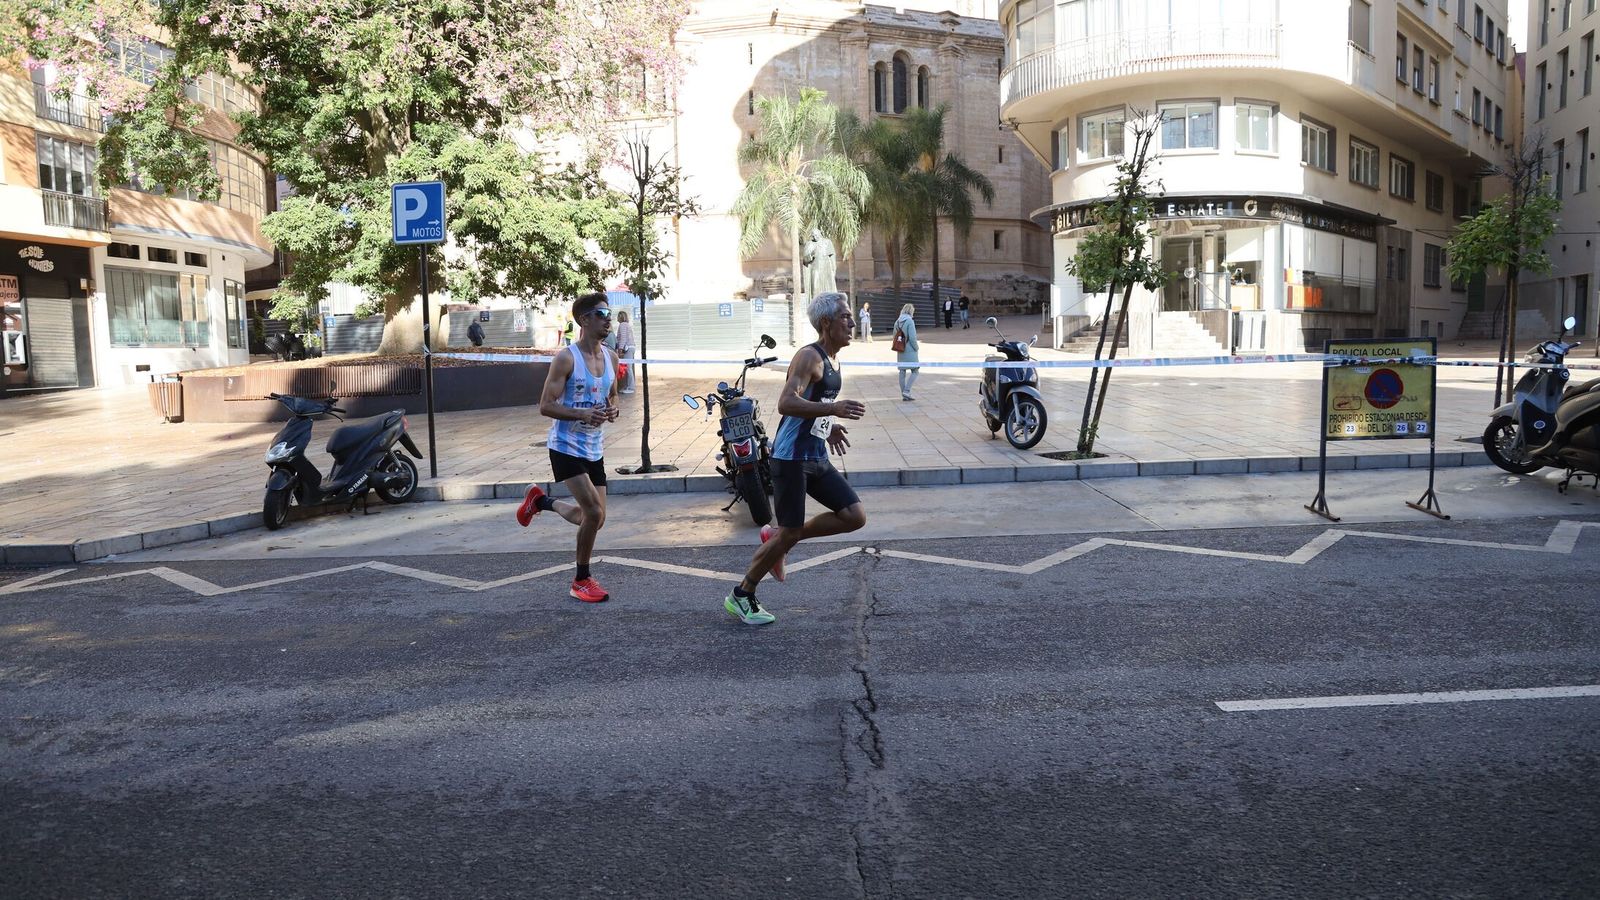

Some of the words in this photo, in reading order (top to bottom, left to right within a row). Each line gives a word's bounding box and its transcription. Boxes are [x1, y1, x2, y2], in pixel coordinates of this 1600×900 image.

[396, 188, 428, 237] P
[1167, 202, 1224, 216] ESTATE
[412, 226, 441, 238] MOTOS
[0, 279, 17, 289] TM
[0, 291, 18, 300] ajero
[1372, 347, 1402, 356] LOCAL
[728, 415, 751, 429] 6492
[1329, 412, 1364, 423] PROHIBIDO
[1365, 412, 1405, 422] ESTACIONAR
[1328, 423, 1342, 434] LAS
[1346, 425, 1355, 433] 23
[1367, 423, 1380, 433] DEL
[1396, 424, 1406, 432] 26
[1416, 423, 1426, 432] 27
